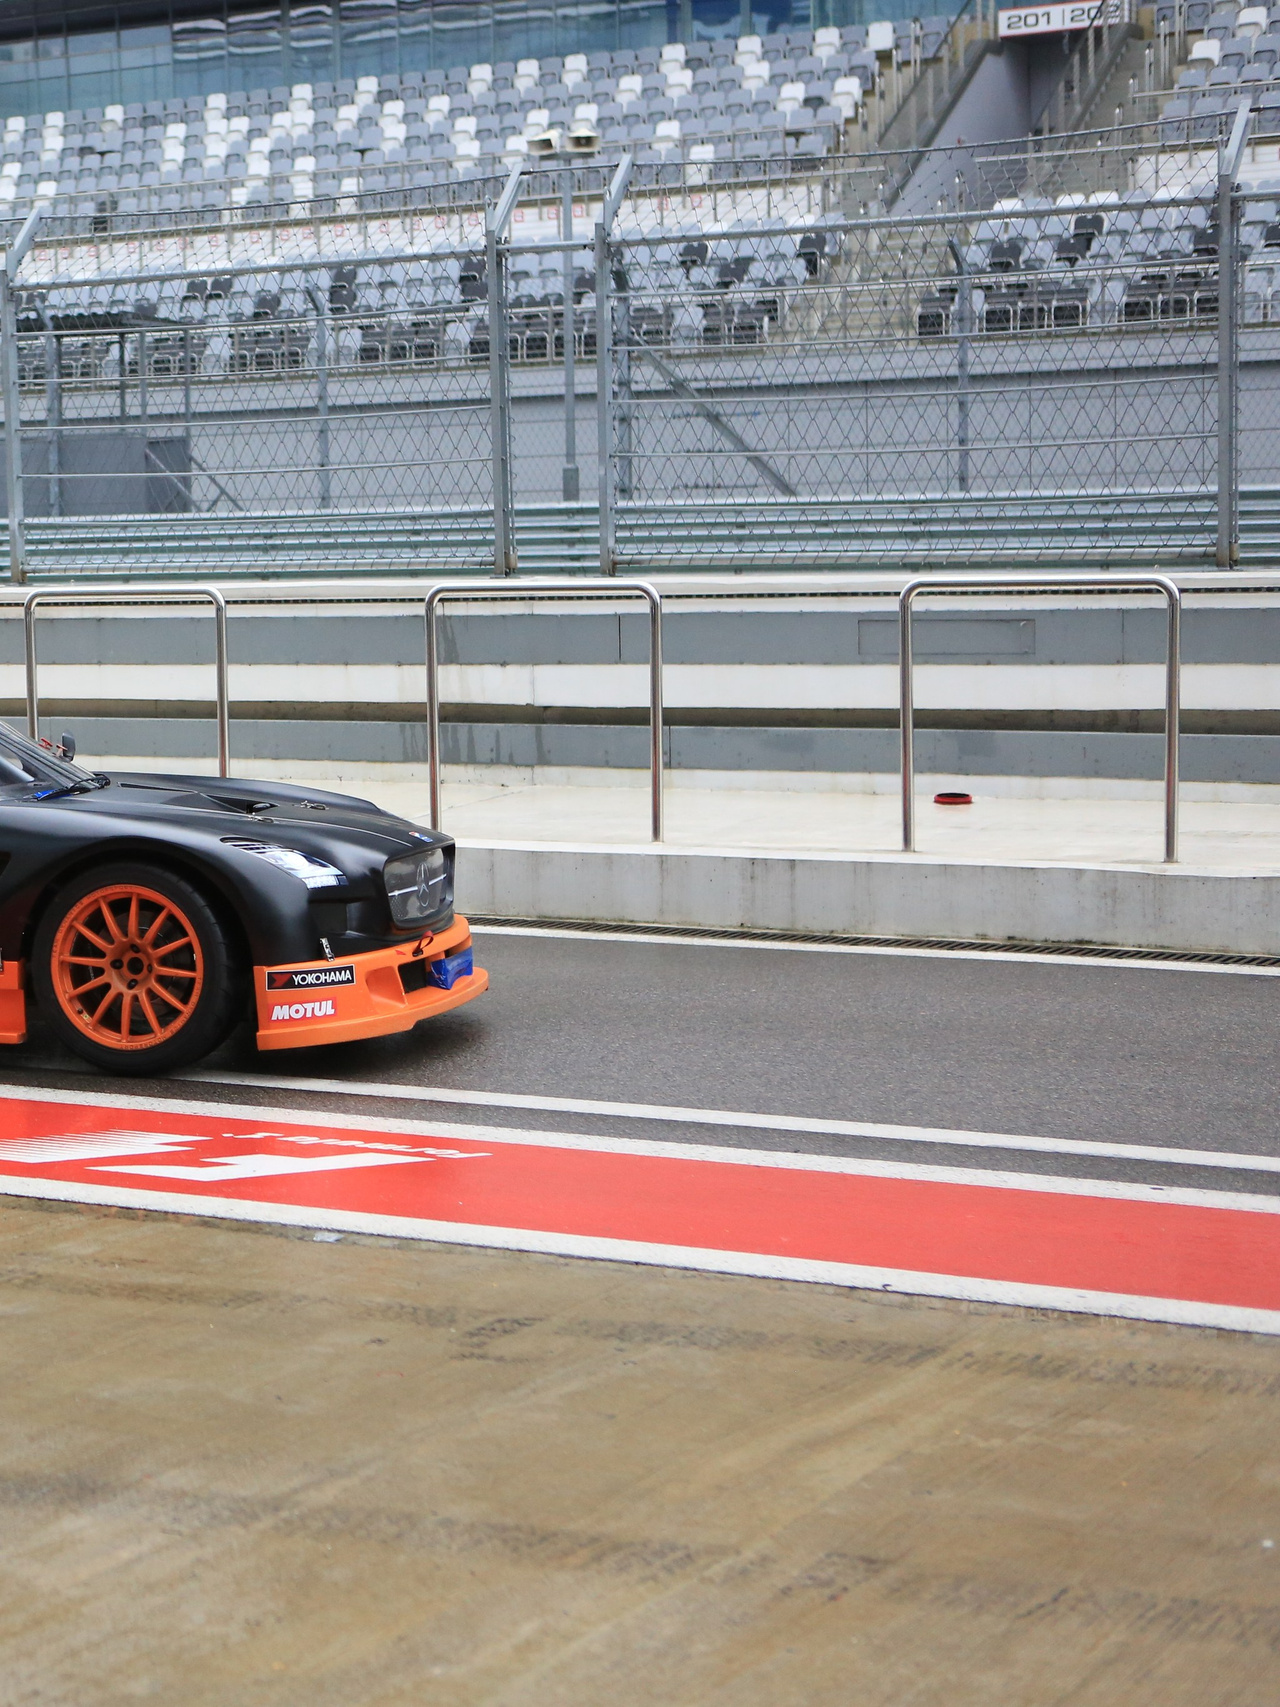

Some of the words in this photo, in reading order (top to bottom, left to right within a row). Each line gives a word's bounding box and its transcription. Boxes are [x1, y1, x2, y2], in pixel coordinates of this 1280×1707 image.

[1007, 11, 1051, 30] 201
[292, 970, 352, 985] YOKOHAMA
[271, 1000, 335, 1020] MOTUL
[279, 1137, 494, 1159] Formula
